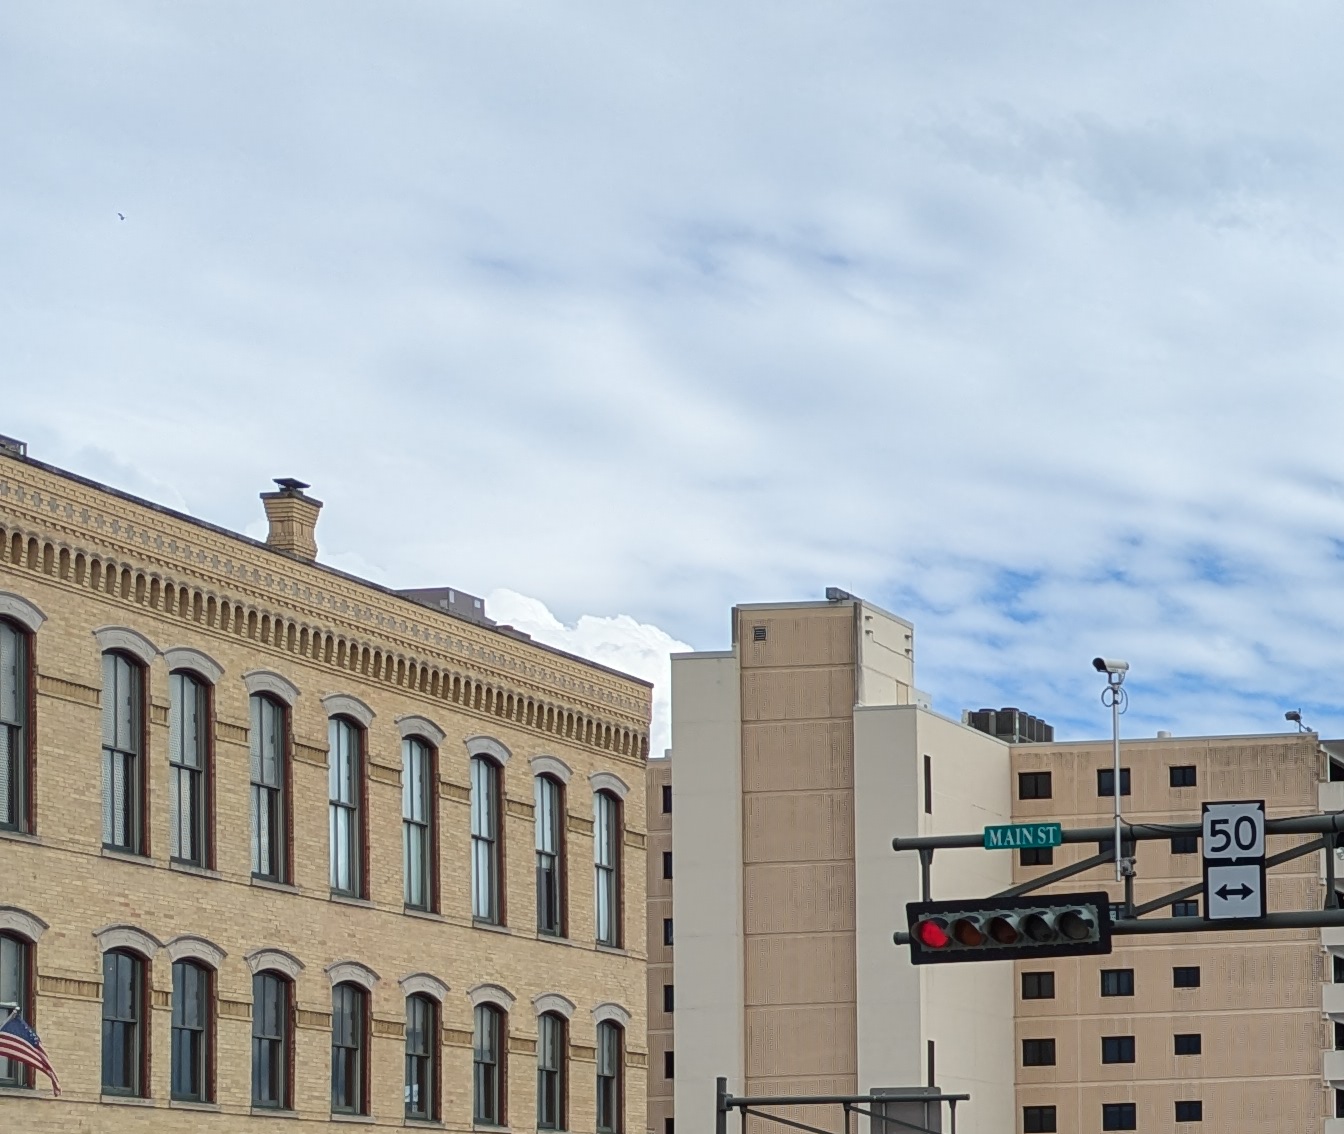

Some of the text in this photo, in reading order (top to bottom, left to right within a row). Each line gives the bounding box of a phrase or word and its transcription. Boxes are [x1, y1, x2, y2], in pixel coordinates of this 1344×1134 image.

[989, 826, 1058, 847] MAIN ST
[1210, 815, 1257, 853] 50
